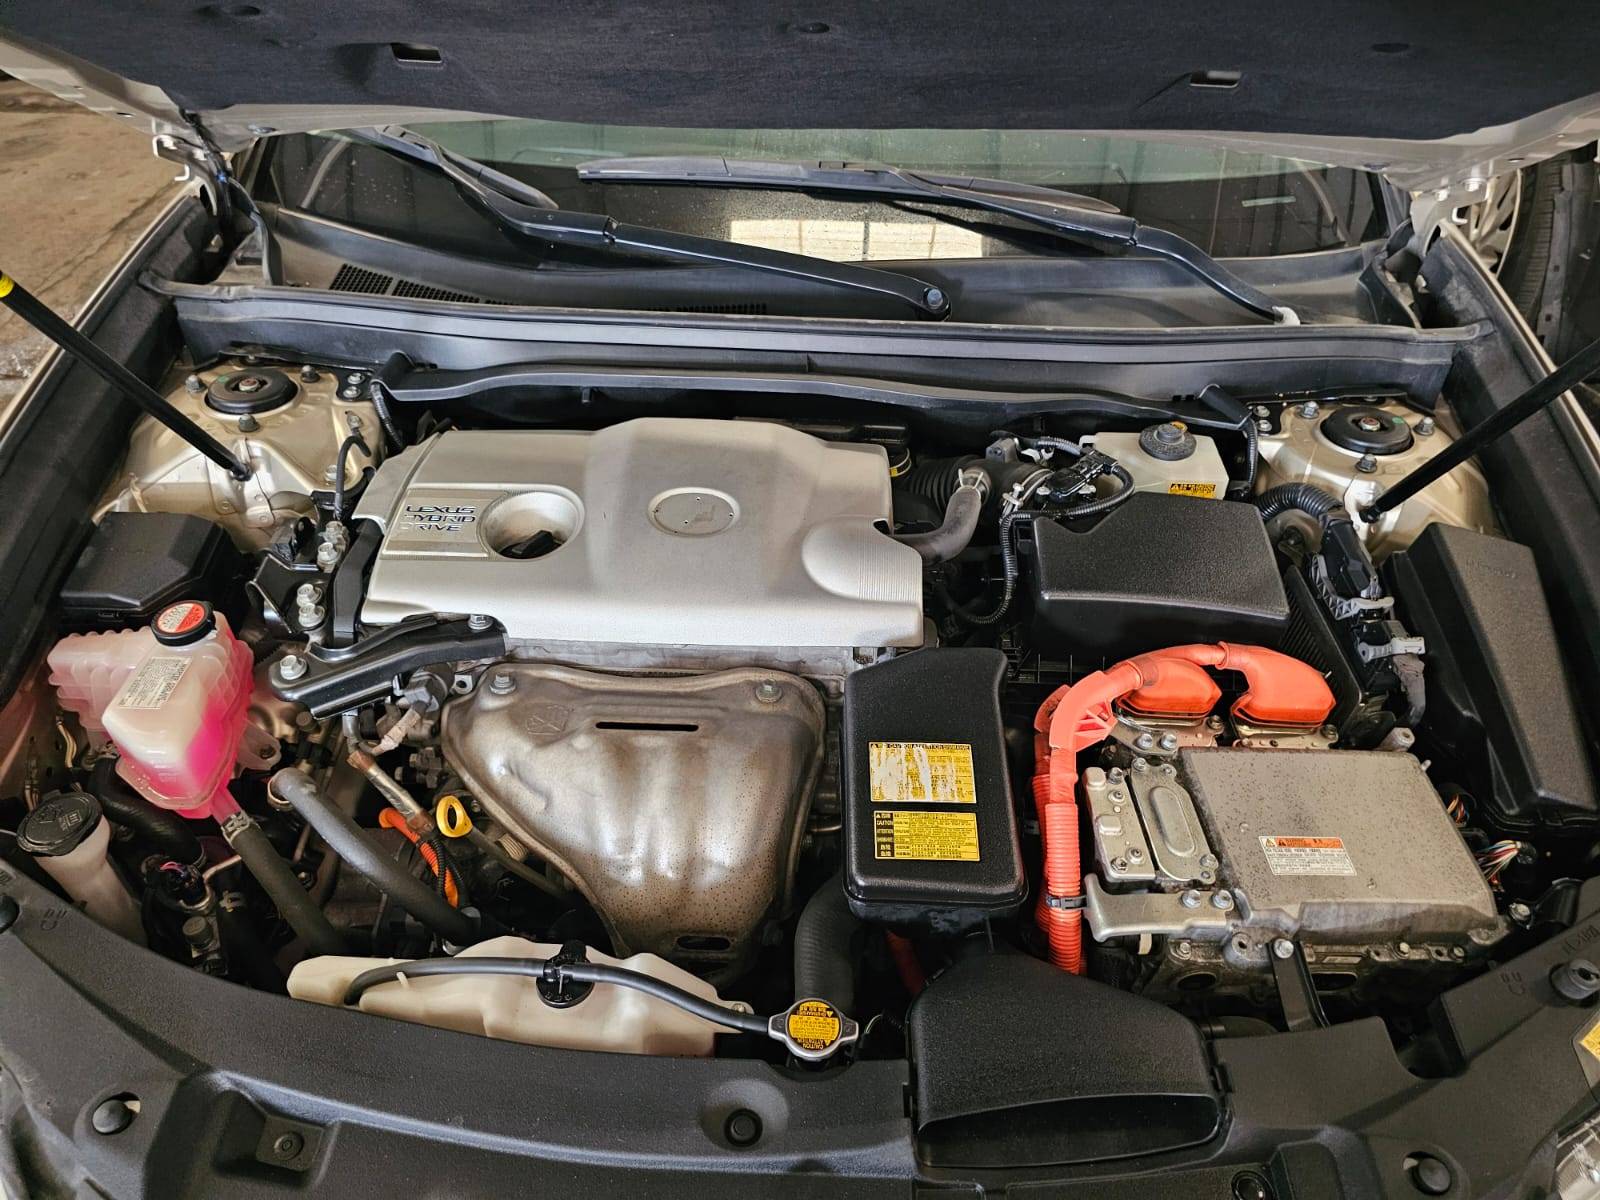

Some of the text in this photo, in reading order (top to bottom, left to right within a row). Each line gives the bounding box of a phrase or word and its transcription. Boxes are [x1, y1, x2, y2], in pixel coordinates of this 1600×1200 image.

[406, 505, 476, 514] LEXUS
[404, 514, 476, 522] HYBRID
[399, 522, 464, 532] DRIVE
